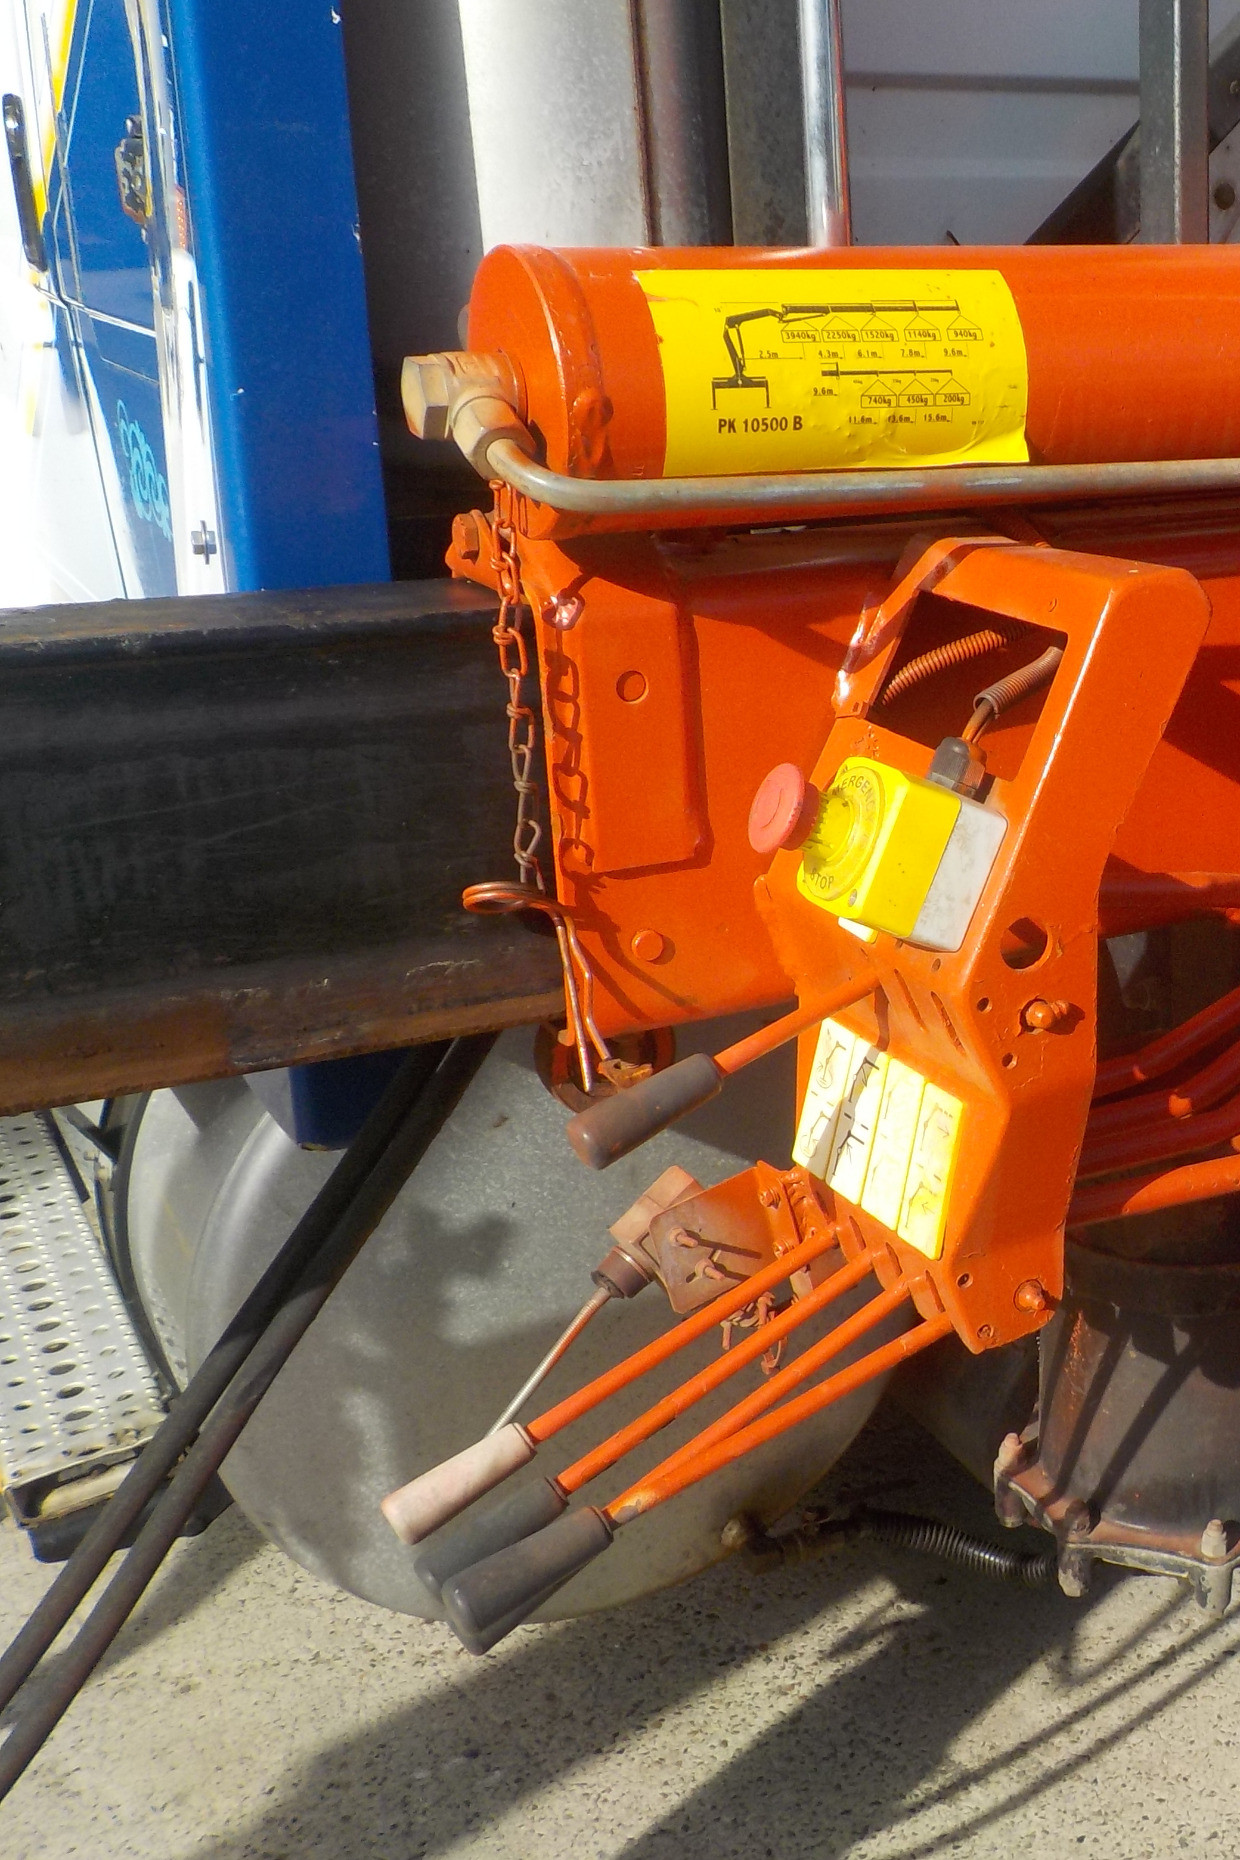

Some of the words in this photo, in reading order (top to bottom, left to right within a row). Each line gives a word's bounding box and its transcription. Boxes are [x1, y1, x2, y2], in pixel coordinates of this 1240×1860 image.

[785, 331, 816, 342] 3940kg
[826, 331, 857, 342] 2250kg
[865, 331, 895, 341] 1520kg
[908, 330, 937, 341] 1140kg
[953, 330, 978, 341] 940kg
[759, 350, 779, 358] 2.5m
[818, 350, 839, 358] 4.3m
[857, 349, 878, 358] 6.1m
[900, 348, 921, 358] 7.8m
[943, 348, 963, 357] 9.6m
[813, 387, 834, 396] 9.6m
[868, 396, 892, 406] 740kg
[906, 395, 929, 405] 450kg
[943, 394, 965, 404] 200kg
[848, 416, 873, 424] 11.6m
[924, 413, 948, 422] 15.6m
[718, 418, 737, 434] PK
[742, 416, 788, 432] 10500
[792, 415, 803, 431] B
[810, 867, 835, 889] STOP
